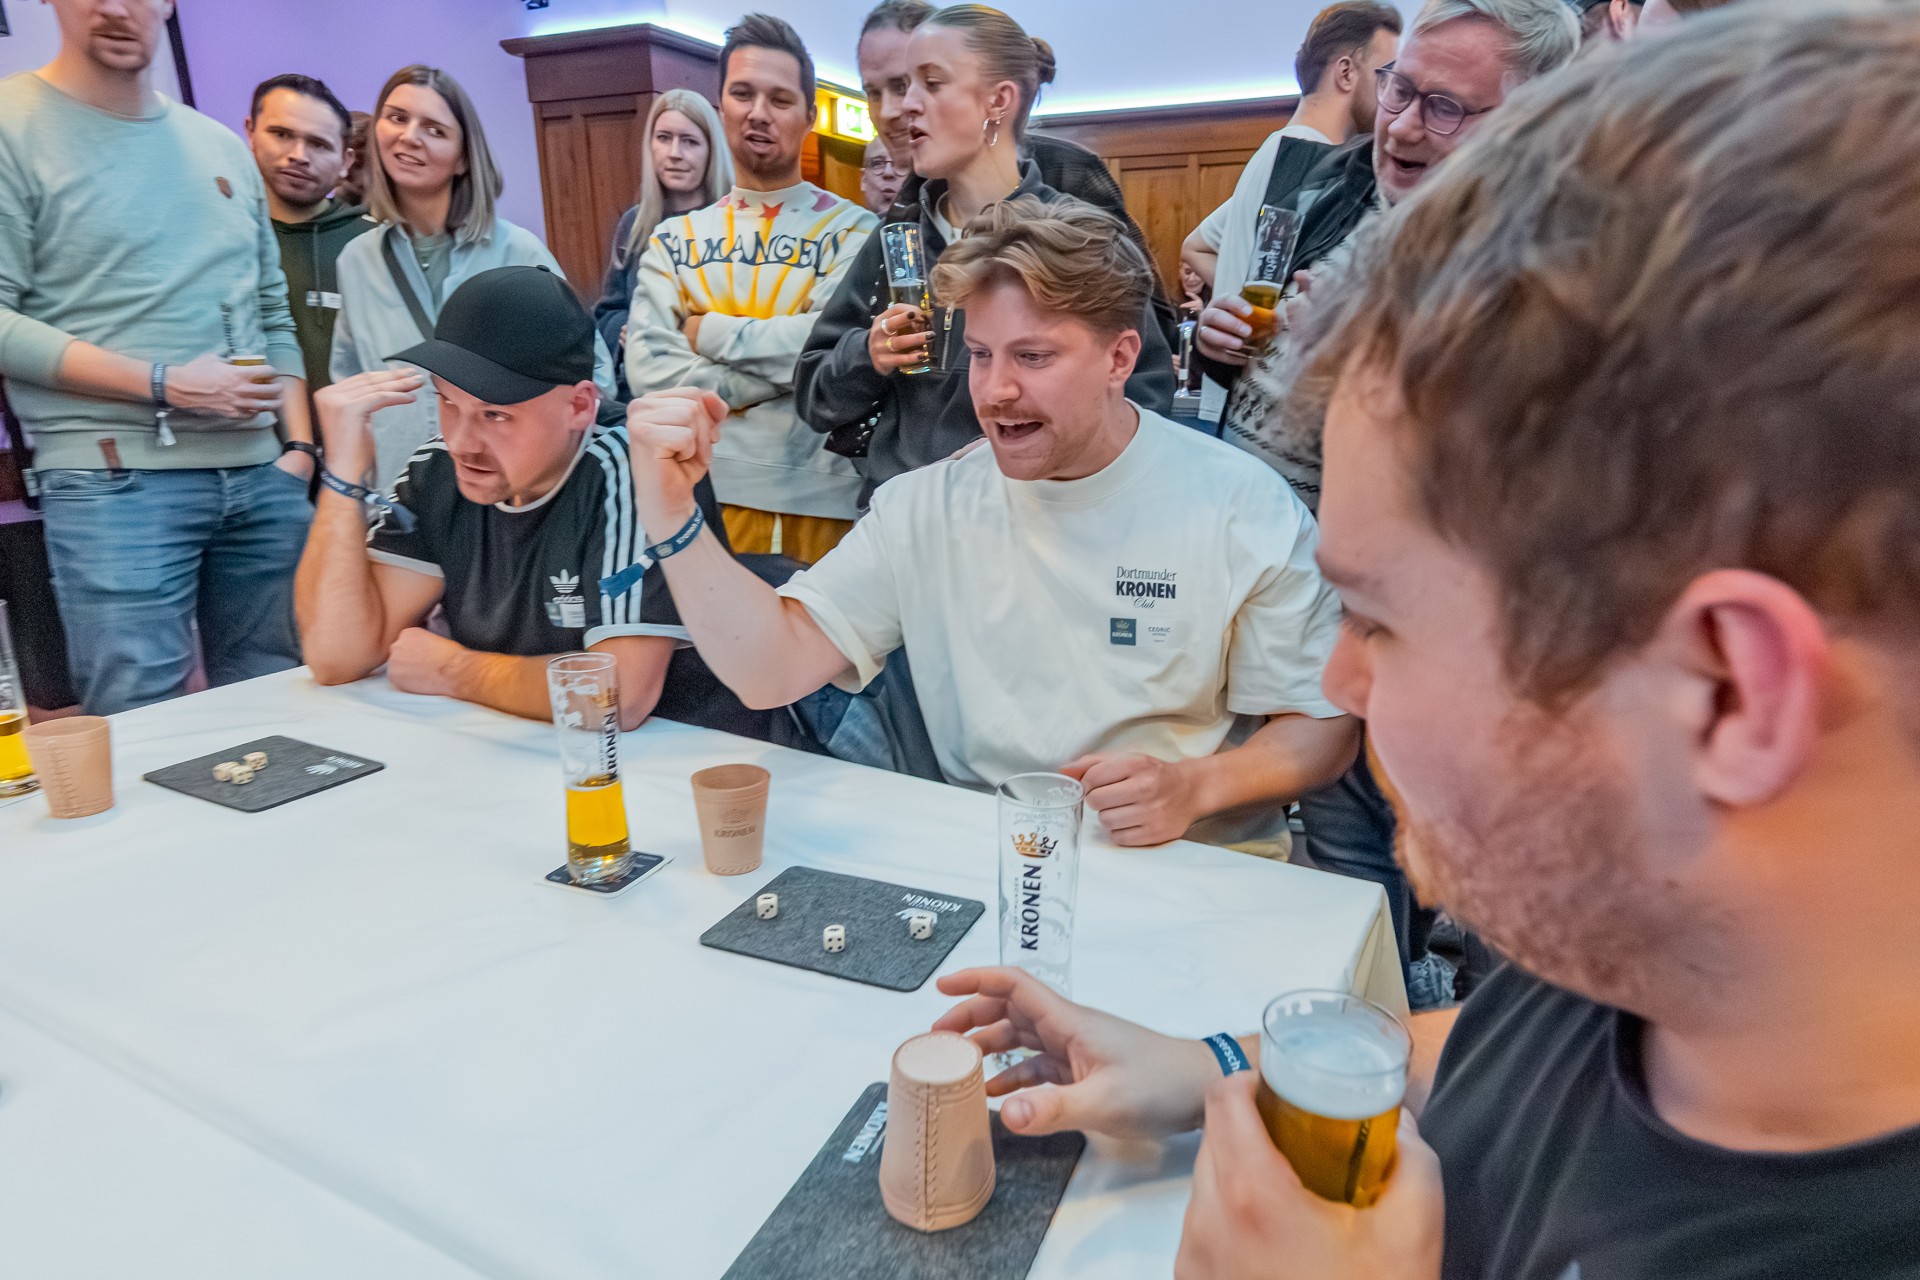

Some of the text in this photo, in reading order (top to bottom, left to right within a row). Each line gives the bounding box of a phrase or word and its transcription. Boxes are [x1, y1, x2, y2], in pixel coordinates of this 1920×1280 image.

[1117, 566, 1177, 581] Dortmunder
[1115, 580, 1176, 599] KRONEN
[1132, 595, 1156, 609] Club
[603, 711, 618, 780] KRONEN
[1020, 863, 1042, 951] KRONEN
